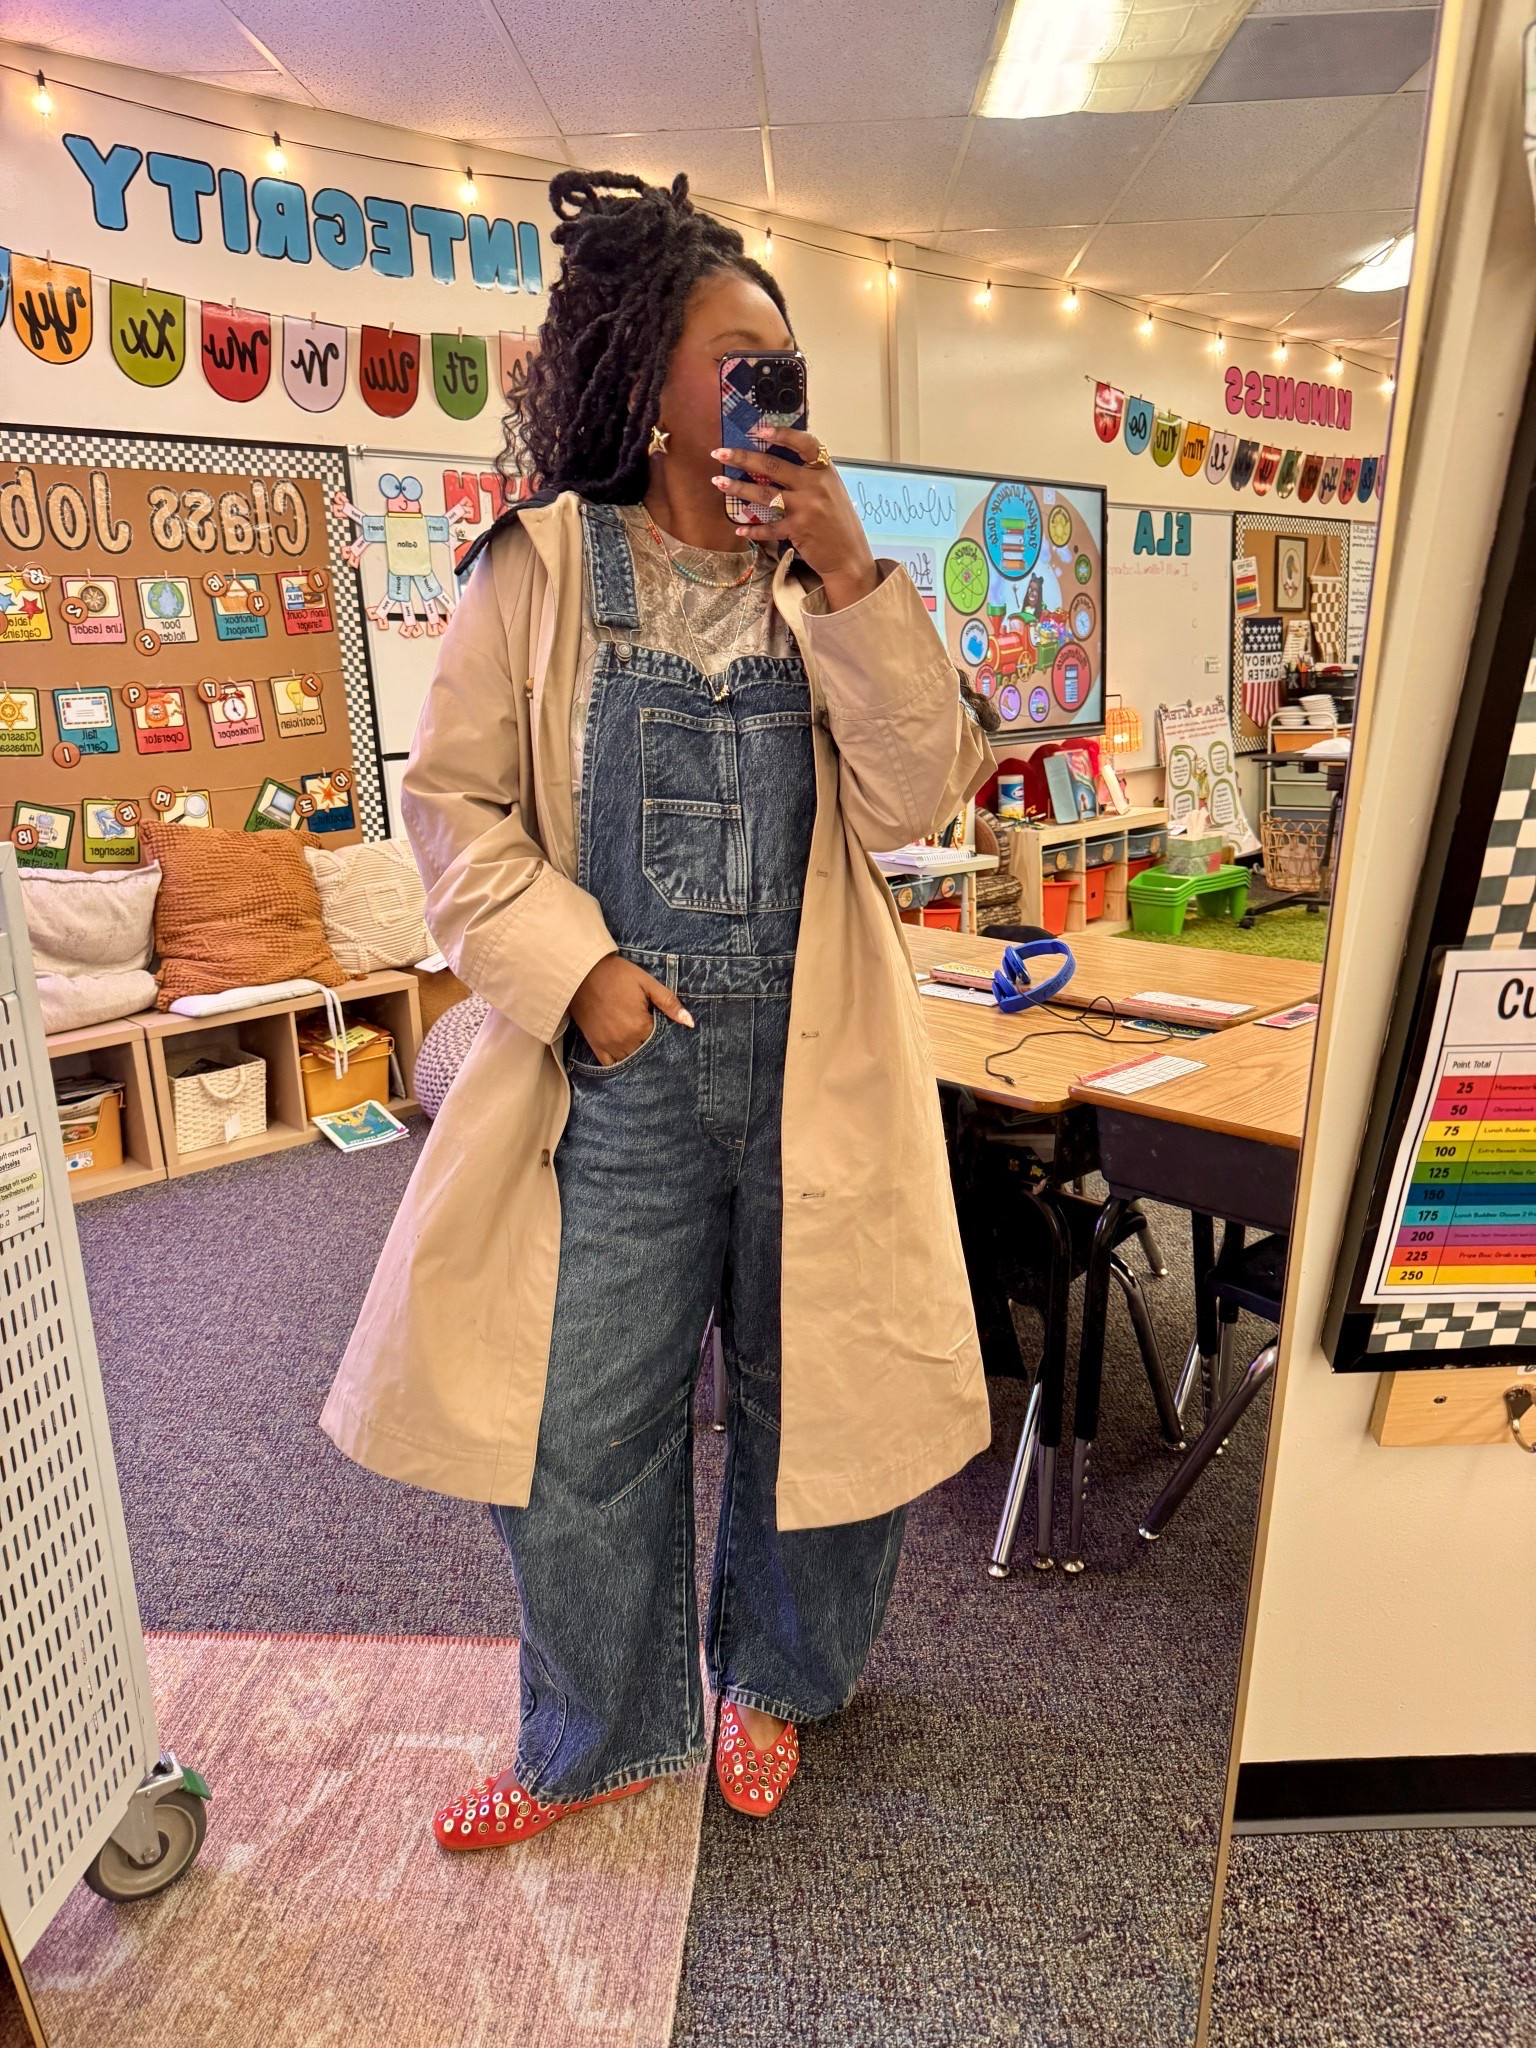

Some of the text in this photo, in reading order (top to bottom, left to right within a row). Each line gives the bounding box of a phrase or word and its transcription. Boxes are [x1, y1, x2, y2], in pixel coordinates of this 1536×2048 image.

[1452, 1060, 1492, 1069] Point Total
[1456, 1082, 1474, 1094] 25
[1450, 1104, 1468, 1116] 50
[1443, 1126, 1460, 1136] 75
[1434, 1146, 1457, 1157] 100
[1428, 1167, 1450, 1179] 125
[1423, 1189, 1445, 1201] 150
[1418, 1210, 1439, 1221] 175
[1410, 1231, 1435, 1242] 200
[1405, 1251, 1429, 1262] 225
[1399, 1270, 1424, 1281] 250
